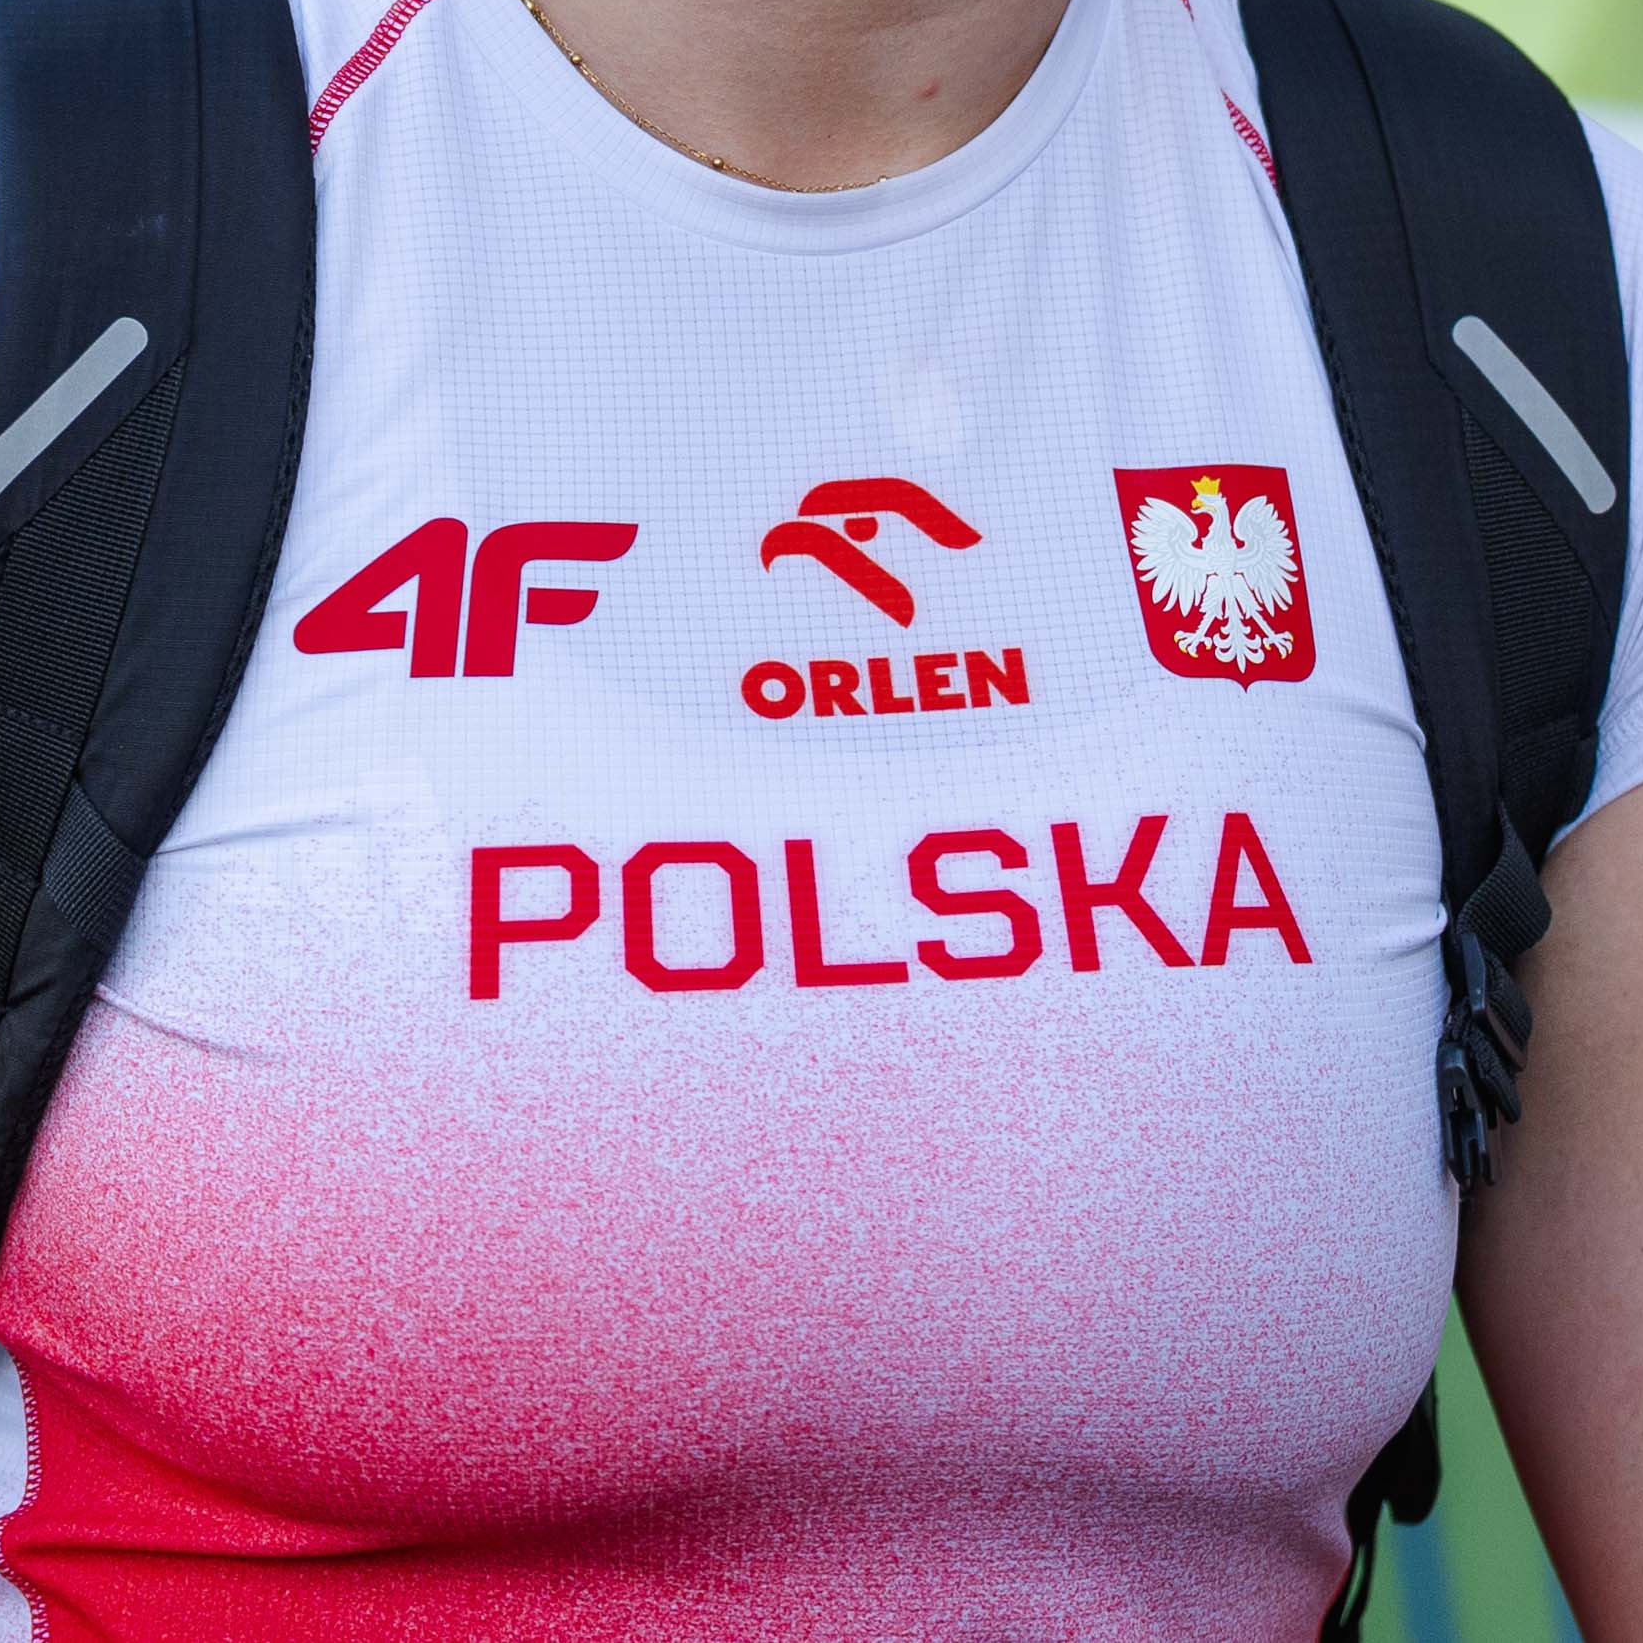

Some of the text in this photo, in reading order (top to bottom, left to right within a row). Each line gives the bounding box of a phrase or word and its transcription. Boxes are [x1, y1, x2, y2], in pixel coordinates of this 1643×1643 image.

[293, 517, 638, 679] 4F
[741, 647, 1031, 720] ORLEN
[468, 811, 1313, 1001] POLSKA
